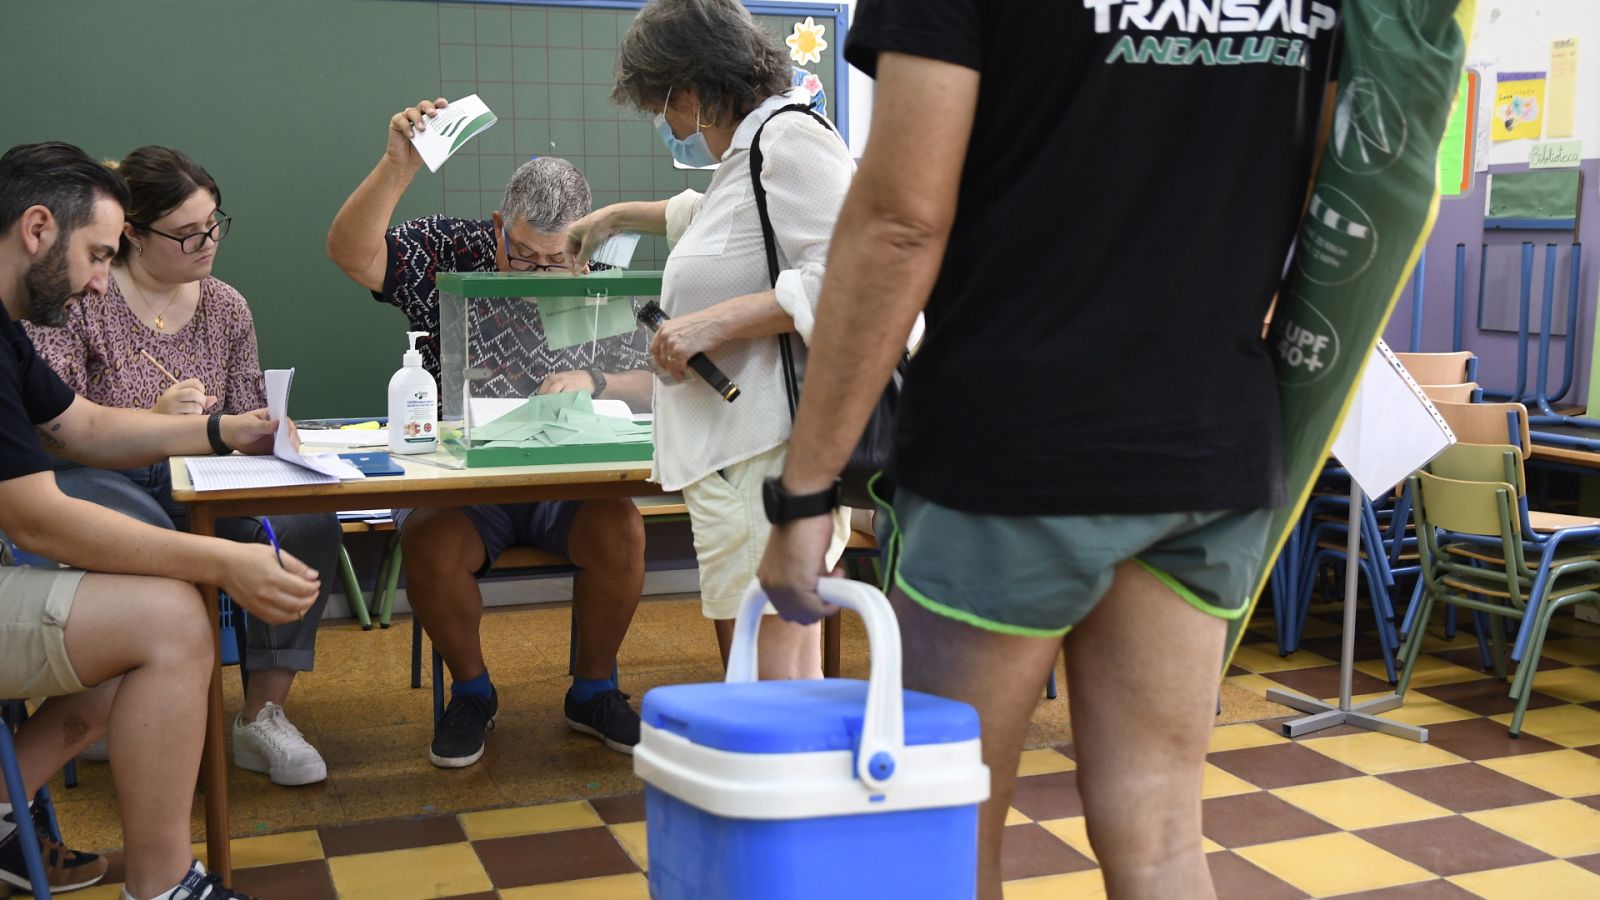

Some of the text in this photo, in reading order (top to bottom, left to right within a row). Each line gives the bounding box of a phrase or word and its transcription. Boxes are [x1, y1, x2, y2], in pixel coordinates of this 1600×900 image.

[1083, 0, 1336, 39] TRANSALP
[1285, 320, 1329, 353] UPF
[1278, 340, 1324, 372] 40+
